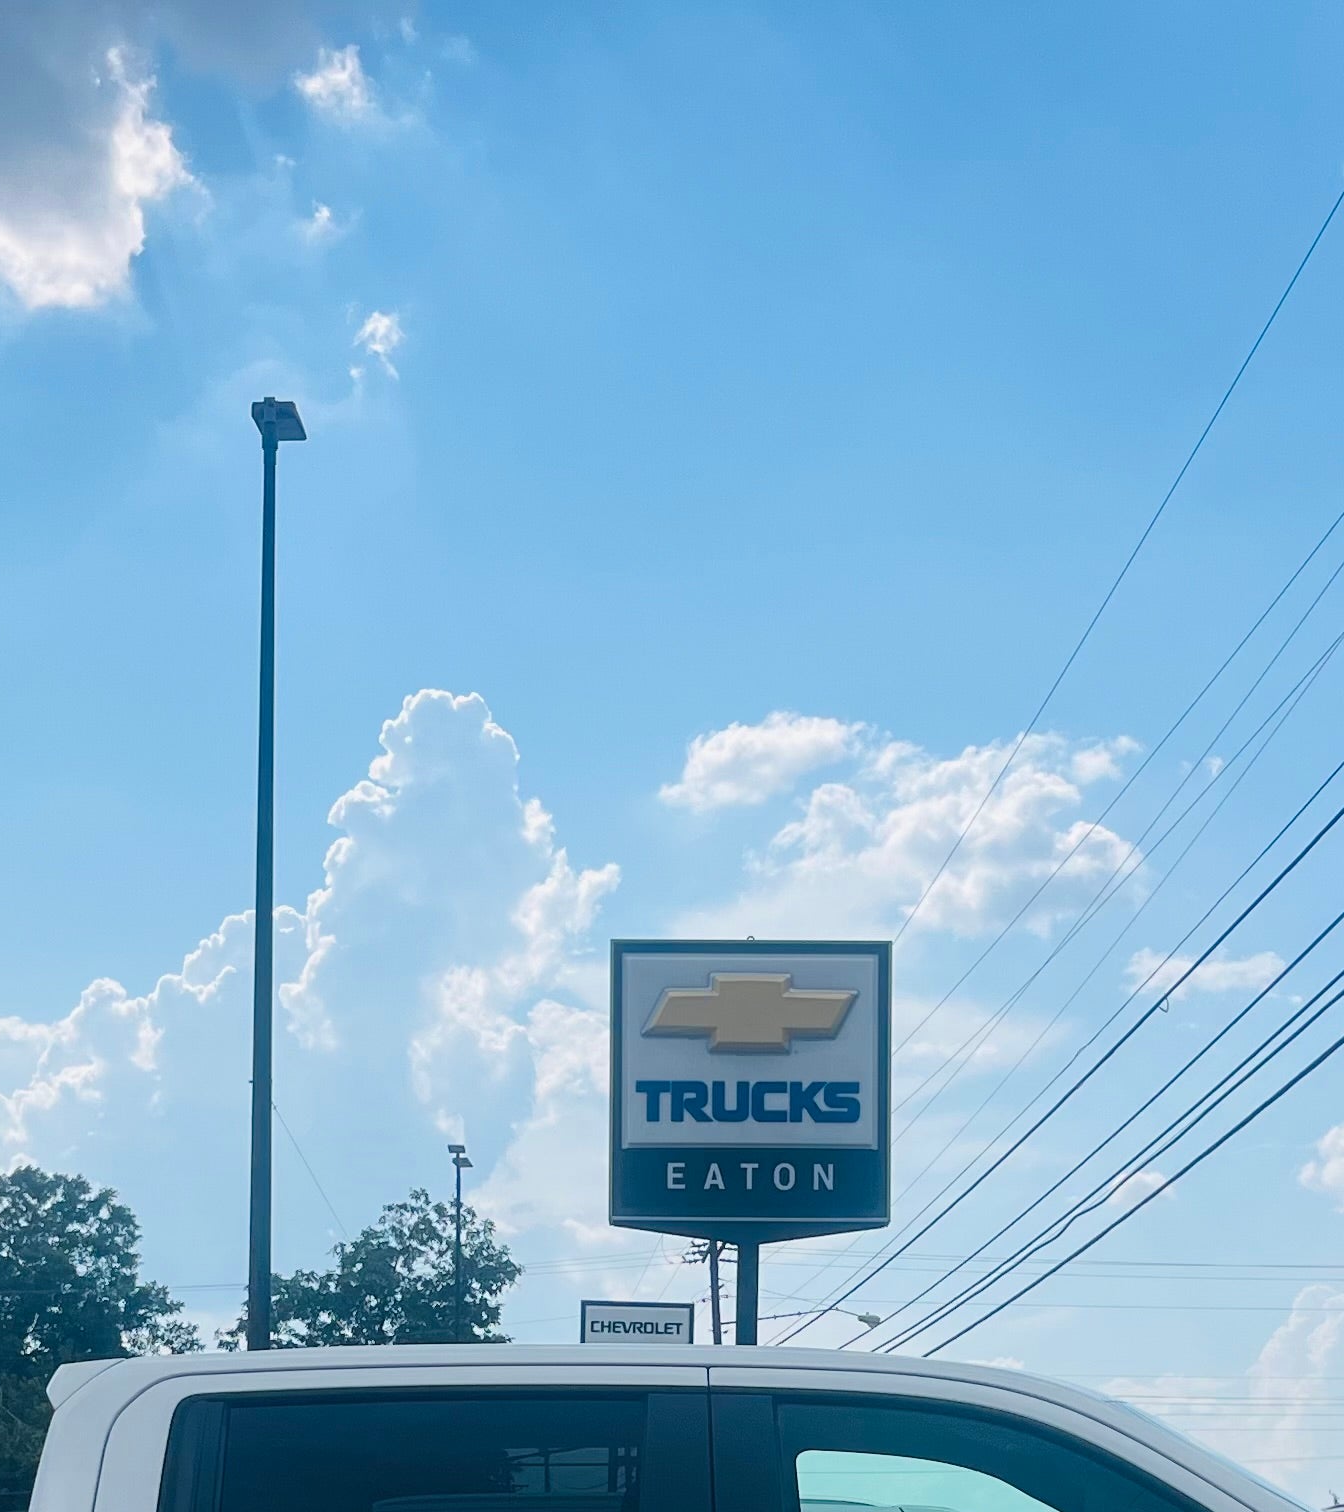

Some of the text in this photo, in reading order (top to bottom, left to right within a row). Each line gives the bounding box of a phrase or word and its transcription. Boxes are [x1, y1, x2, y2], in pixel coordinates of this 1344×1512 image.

[635, 1080, 861, 1124] TRUCKS
[666, 1162, 834, 1191] EATON
[590, 1320, 684, 1335] CHEVROLET
